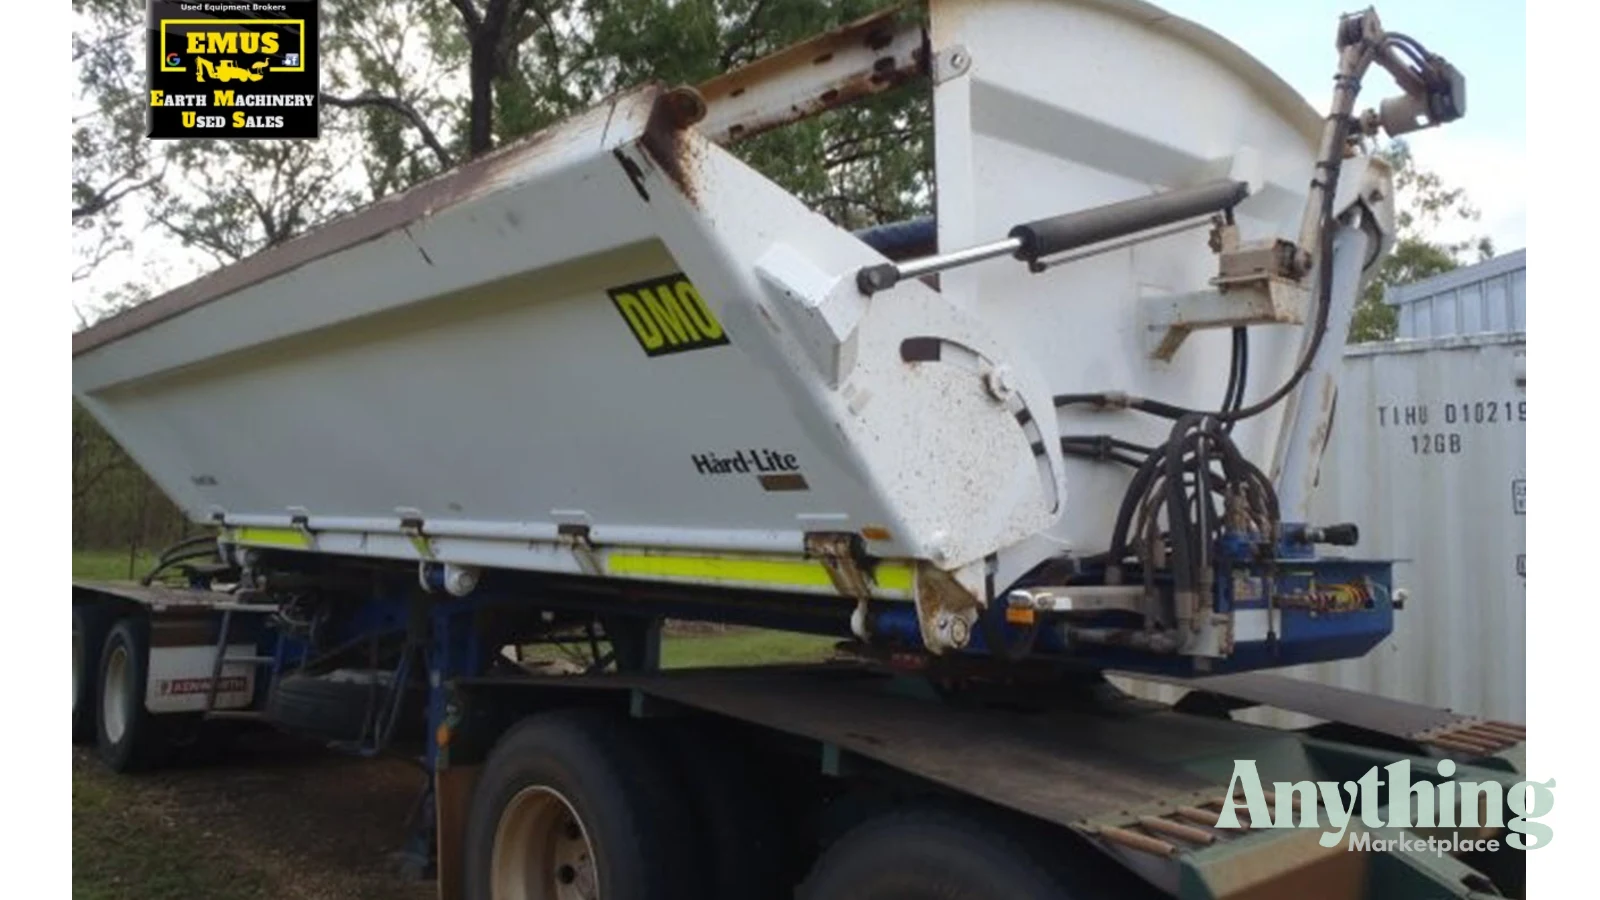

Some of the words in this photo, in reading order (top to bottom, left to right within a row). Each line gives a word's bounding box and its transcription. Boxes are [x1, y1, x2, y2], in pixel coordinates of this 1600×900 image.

[615, 281, 723, 350] DMO
[1378, 405, 1428, 426] TIHU
[1411, 433, 1461, 454] 12GB
